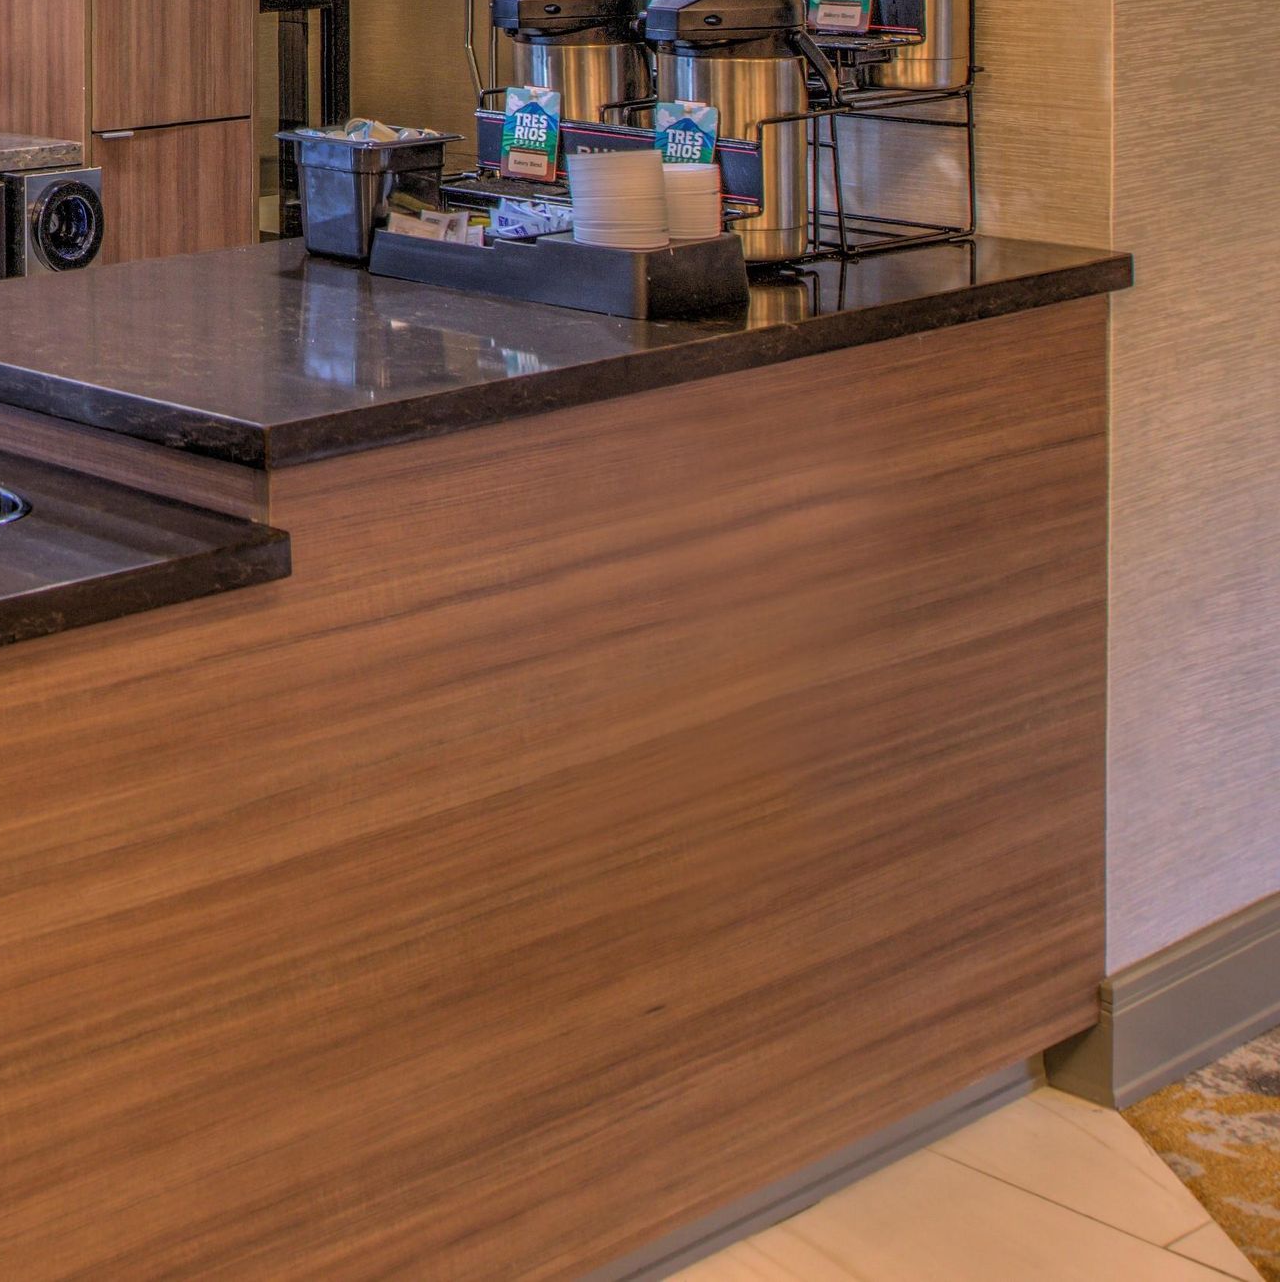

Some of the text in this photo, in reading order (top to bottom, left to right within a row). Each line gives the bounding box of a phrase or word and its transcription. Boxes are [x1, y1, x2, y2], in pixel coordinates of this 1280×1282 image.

[515, 112, 548, 128] TRES
[514, 125, 547, 141] RIOS
[665, 128, 704, 145] TRES
[666, 143, 701, 158] RIOS
